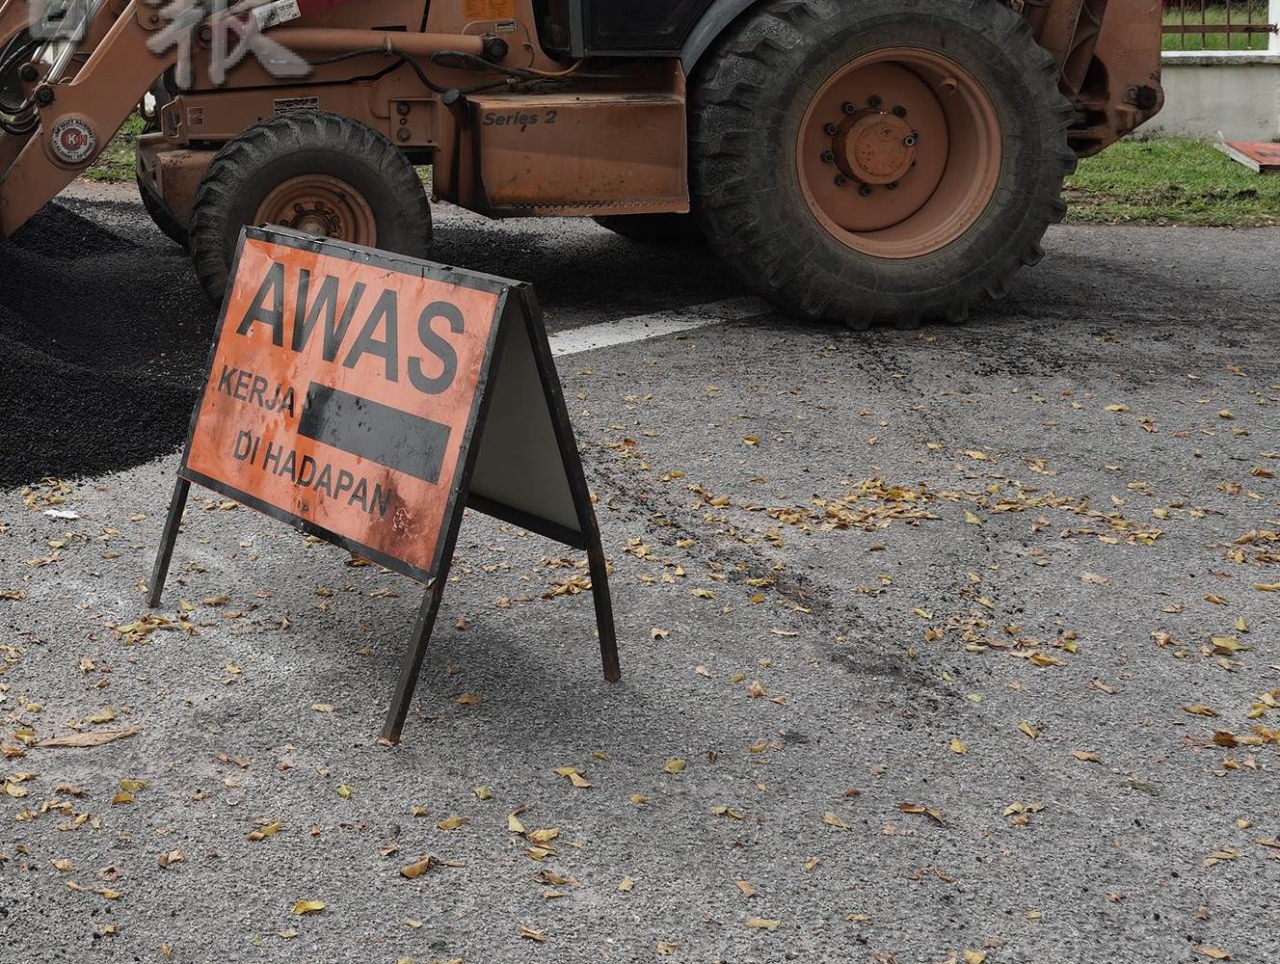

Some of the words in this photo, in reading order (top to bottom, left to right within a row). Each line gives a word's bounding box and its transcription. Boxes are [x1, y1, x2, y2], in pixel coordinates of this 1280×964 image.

[483, 111, 539, 126] Series
[544, 110, 557, 124] 2
[236, 262, 465, 394] AWAS
[217, 364, 296, 418] KERJA
[233, 430, 260, 463] DI
[261, 448, 394, 518] HADAPAN
